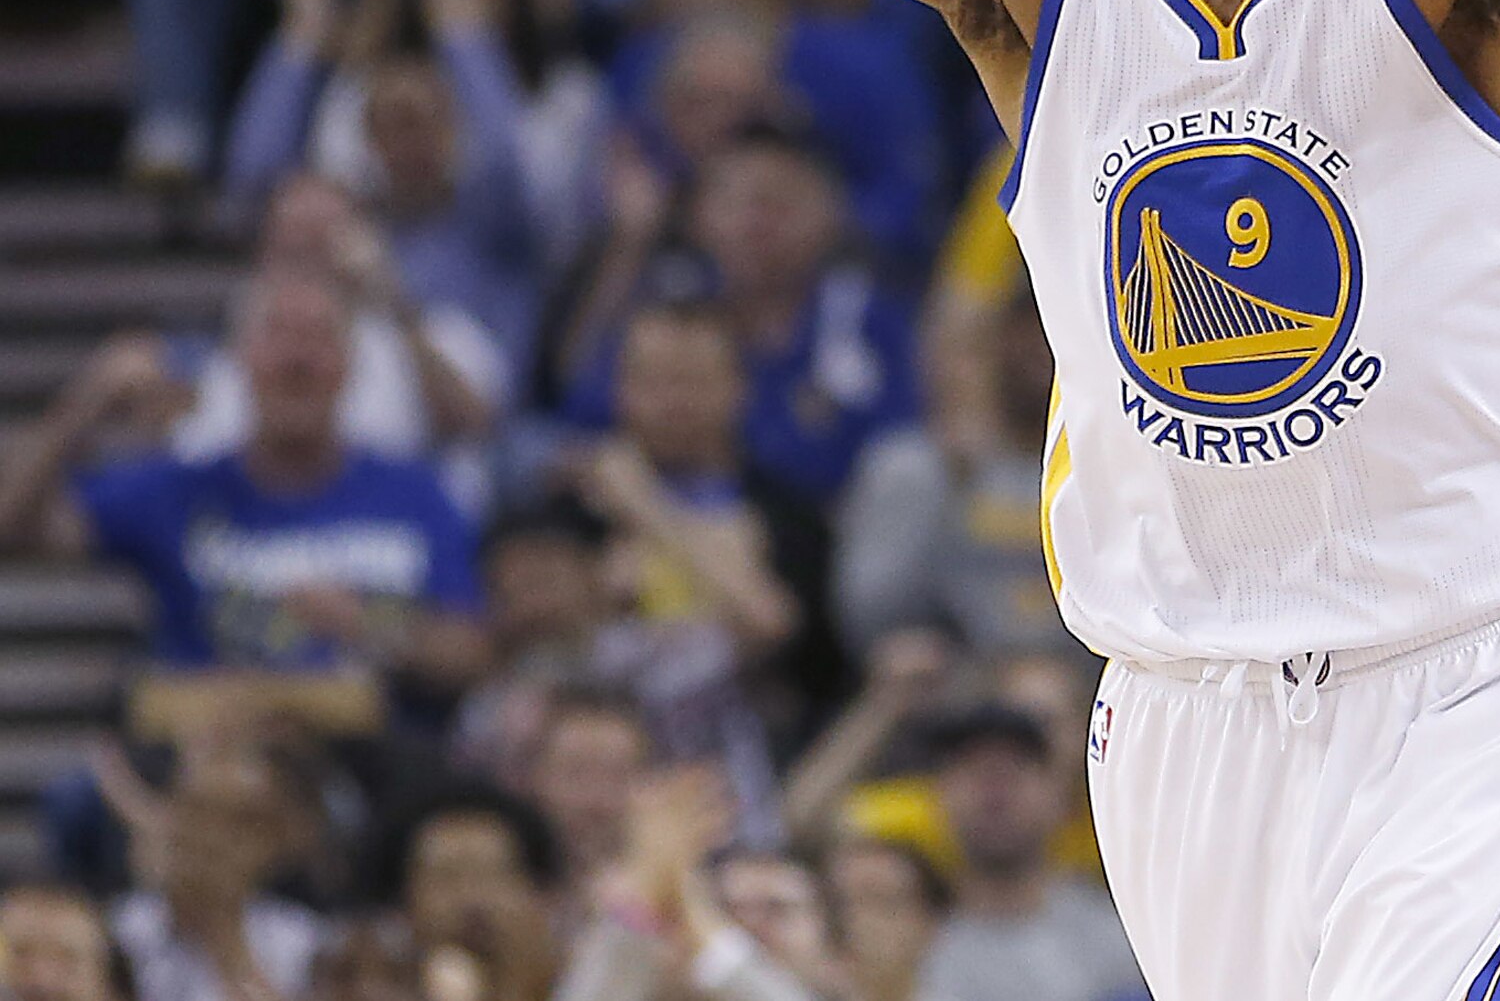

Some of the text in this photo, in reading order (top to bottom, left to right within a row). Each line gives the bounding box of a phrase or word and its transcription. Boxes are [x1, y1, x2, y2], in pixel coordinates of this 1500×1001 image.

[1093, 110, 1351, 204] GOLDEN STATE
[1224, 196, 1272, 270] 9
[1120, 347, 1382, 465] WARRIORS
